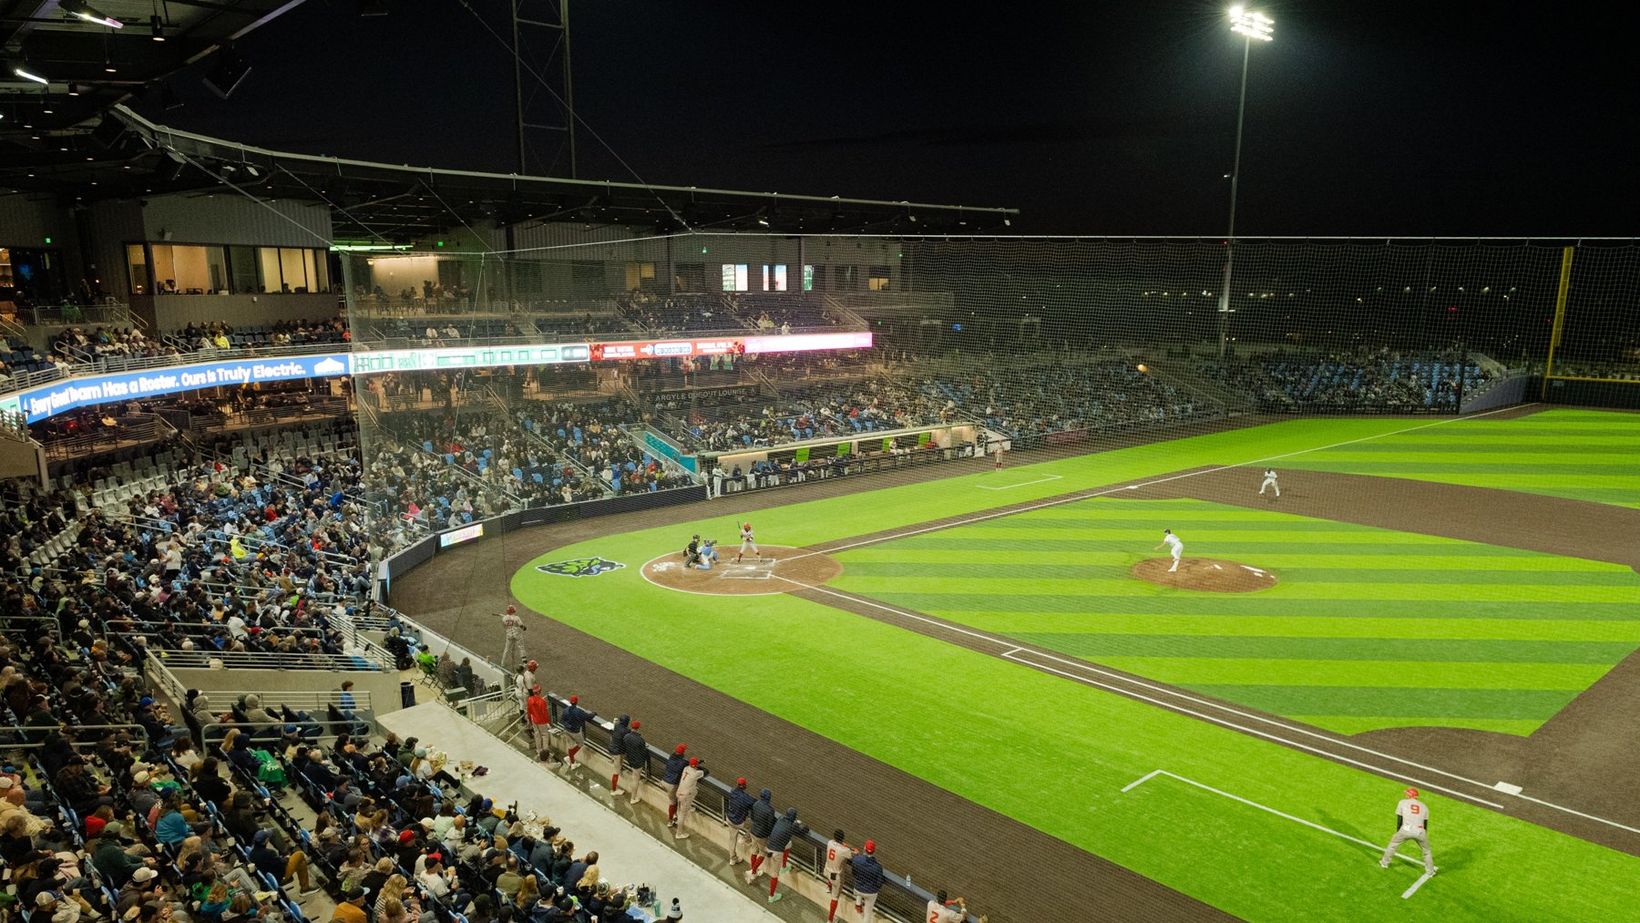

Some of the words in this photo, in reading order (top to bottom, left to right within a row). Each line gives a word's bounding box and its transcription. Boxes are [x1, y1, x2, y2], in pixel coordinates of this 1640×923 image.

[68, 386, 102, 403] Team
[102, 381, 128, 397] Has
[129, 380, 138, 393] a
[139, 375, 180, 392] Roster.
[181, 372, 206, 386] Ours
[217, 366, 251, 383] Truly
[253, 361, 306, 379] Electric.
[656, 393, 686, 401] ARGYLE
[718, 388, 747, 396] LOUNGE
[1410, 804, 1420, 815] 9
[828, 848, 836, 861] 6
[929, 910, 939, 923] 2
